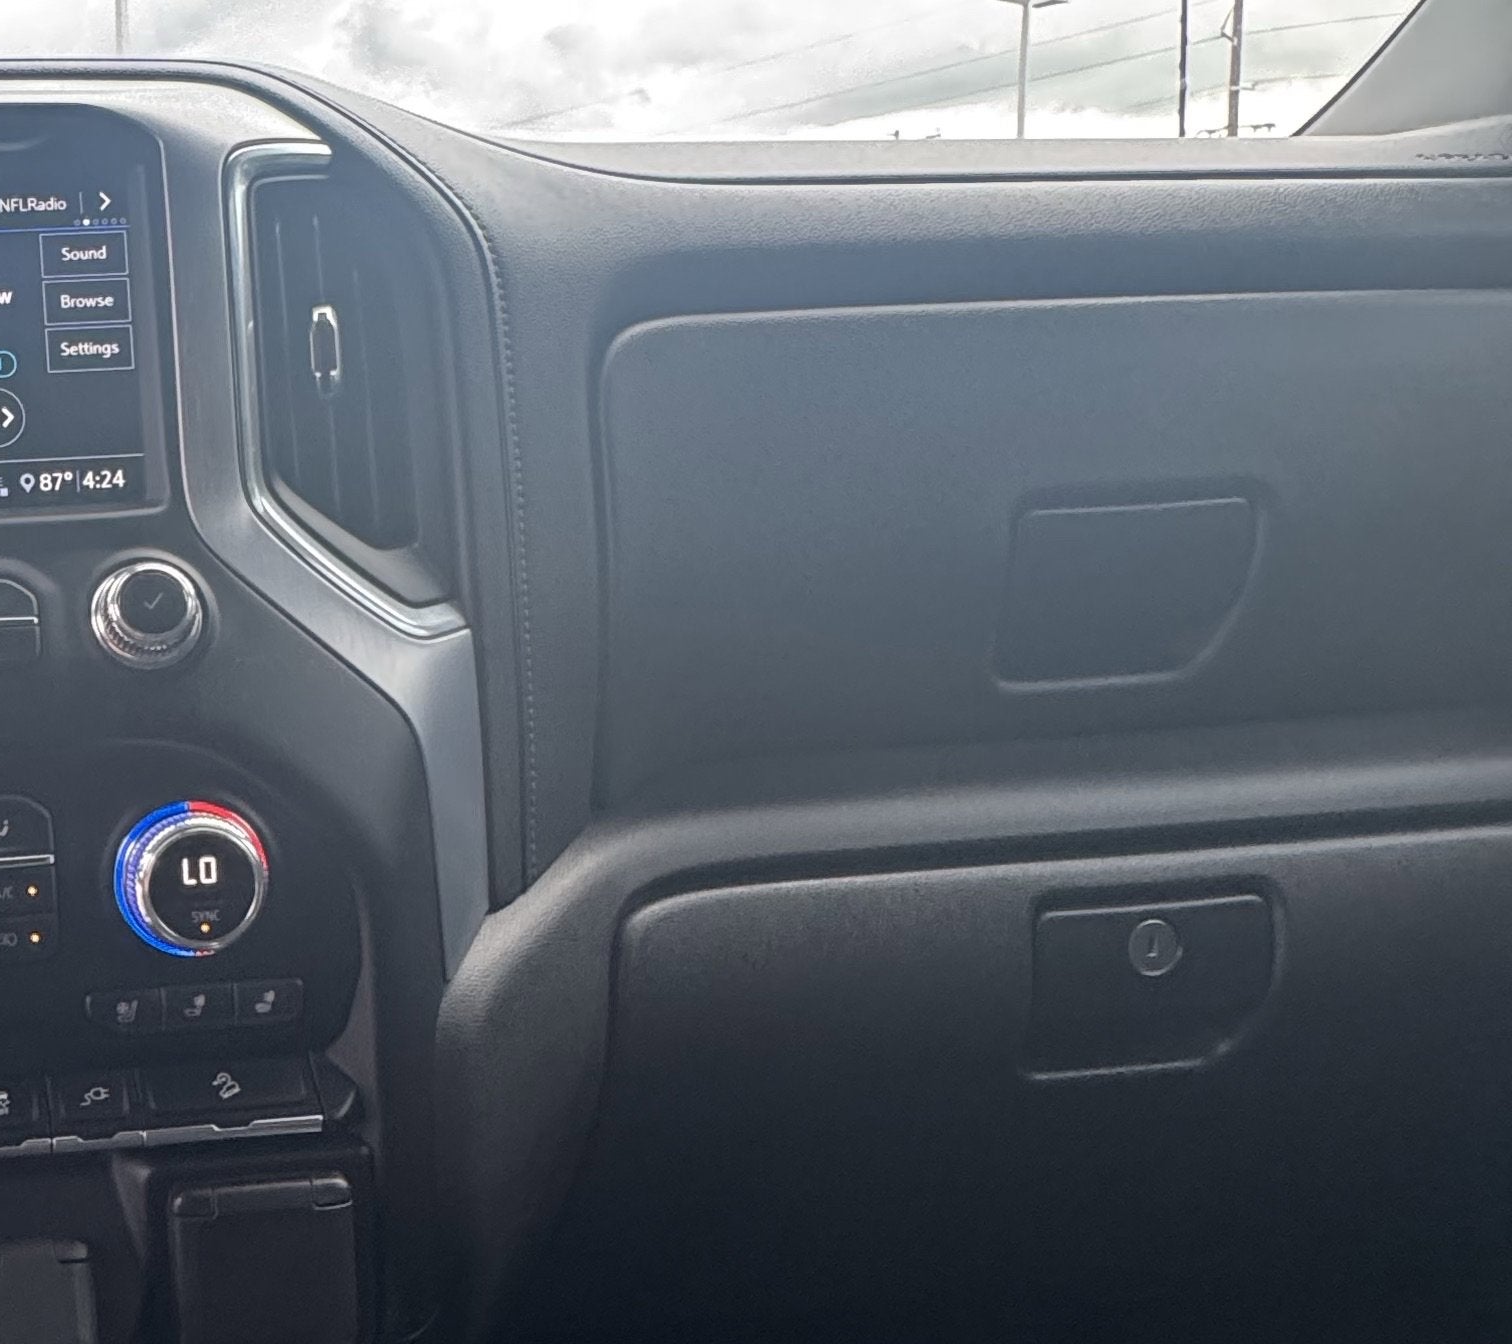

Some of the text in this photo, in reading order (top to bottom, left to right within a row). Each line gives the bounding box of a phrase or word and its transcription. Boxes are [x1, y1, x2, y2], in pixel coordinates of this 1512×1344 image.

[61, 245, 107, 261] Sound
[60, 293, 115, 309] Browse
[60, 341, 121, 359] Settings
[39, 471, 73, 492] 87°
[82, 469, 126, 489] 4:24
